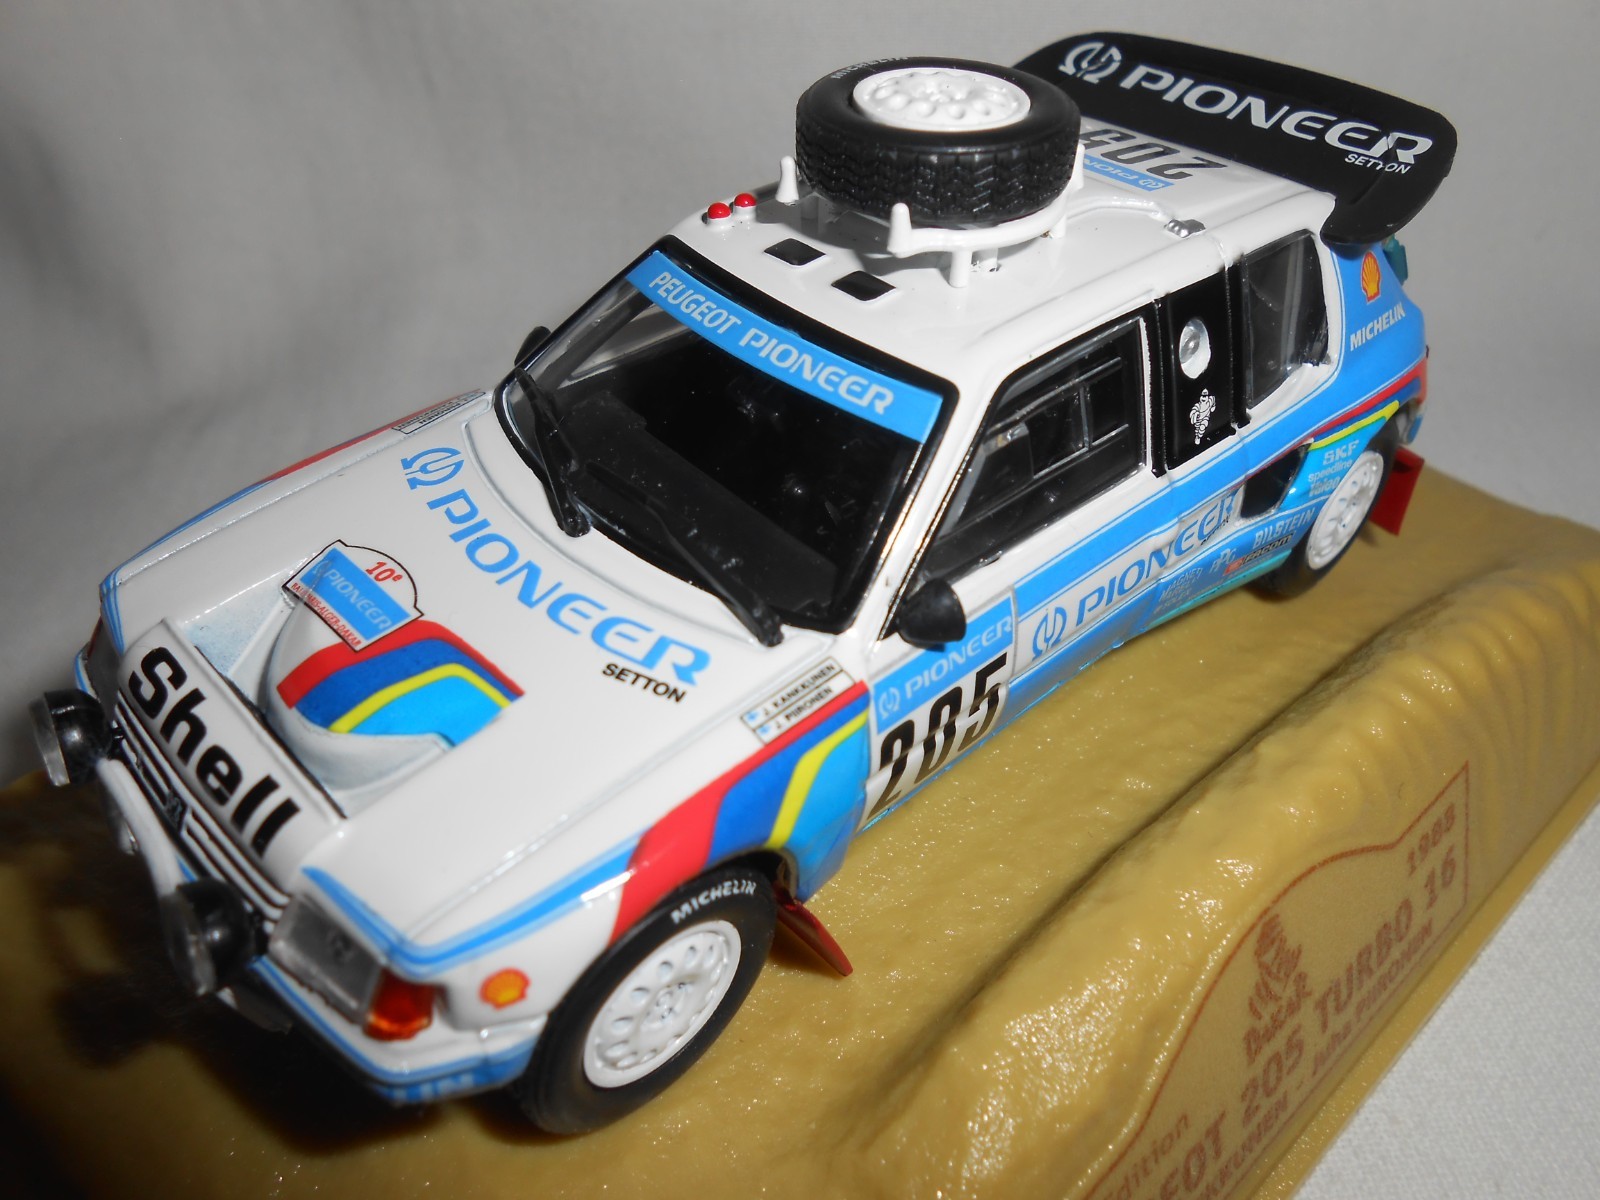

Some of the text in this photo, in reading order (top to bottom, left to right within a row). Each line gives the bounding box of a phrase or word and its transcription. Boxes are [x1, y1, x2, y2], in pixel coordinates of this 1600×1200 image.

[1120, 64, 1434, 165] PIONEER
[1344, 153, 1411, 175] SETTON
[649, 272, 895, 415] PEUGEOT PIONEER
[1350, 303, 1407, 352] MICHELIN
[1323, 440, 1360, 466] SKF
[1076, 488, 1240, 627] PIONEER
[1253, 507, 1316, 549] BILSTEIN
[325, 569, 393, 630] PIONEER
[426, 488, 711, 687] PIONEER
[602, 663, 687, 703] SETTON
[904, 615, 1013, 700] PIONEER
[128, 646, 301, 860] Shell
[867, 652, 1008, 821] 205
[670, 879, 757, 925] MICHELIN
[1241, 1023, 1305, 1129] 205
[1314, 898, 1413, 1034] TURBO
[1424, 845, 1456, 910] 16
